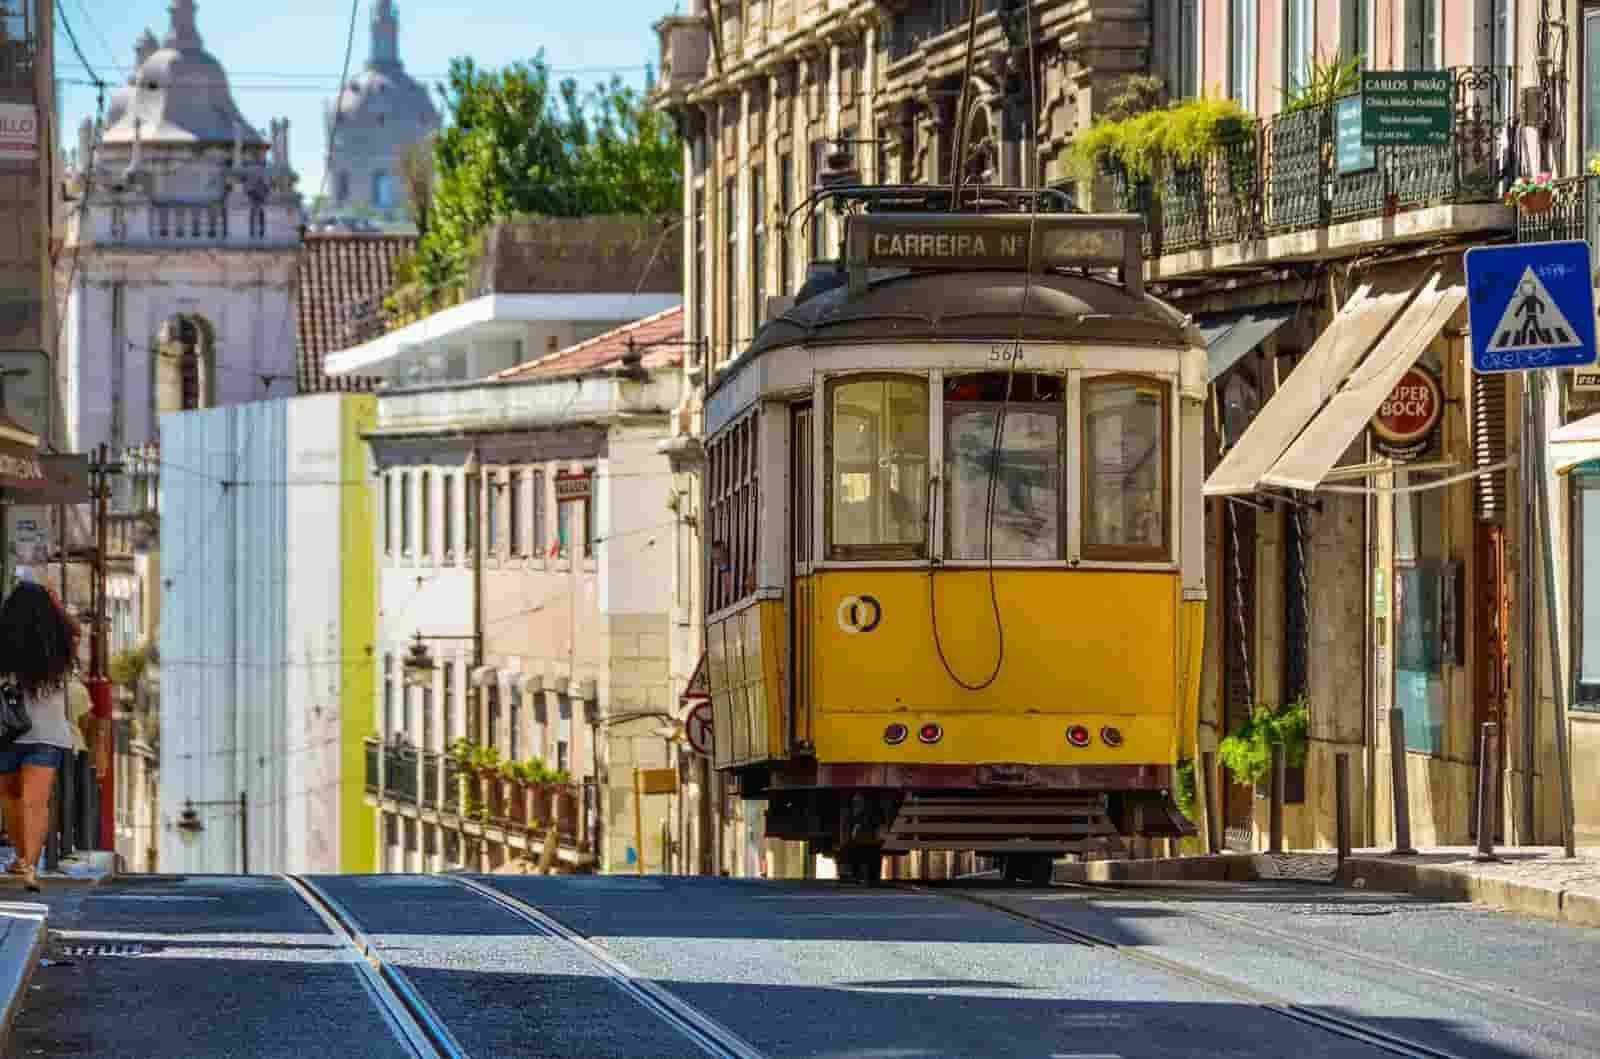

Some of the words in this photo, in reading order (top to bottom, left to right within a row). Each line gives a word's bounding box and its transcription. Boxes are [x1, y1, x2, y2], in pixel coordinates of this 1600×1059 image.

[1366, 79, 1408, 91] CARLOS
[873, 232, 986, 257] CARREIRA
[989, 344, 1024, 361] 564
[1390, 385, 1430, 402] UPER
[1381, 400, 1427, 417] BOCK
